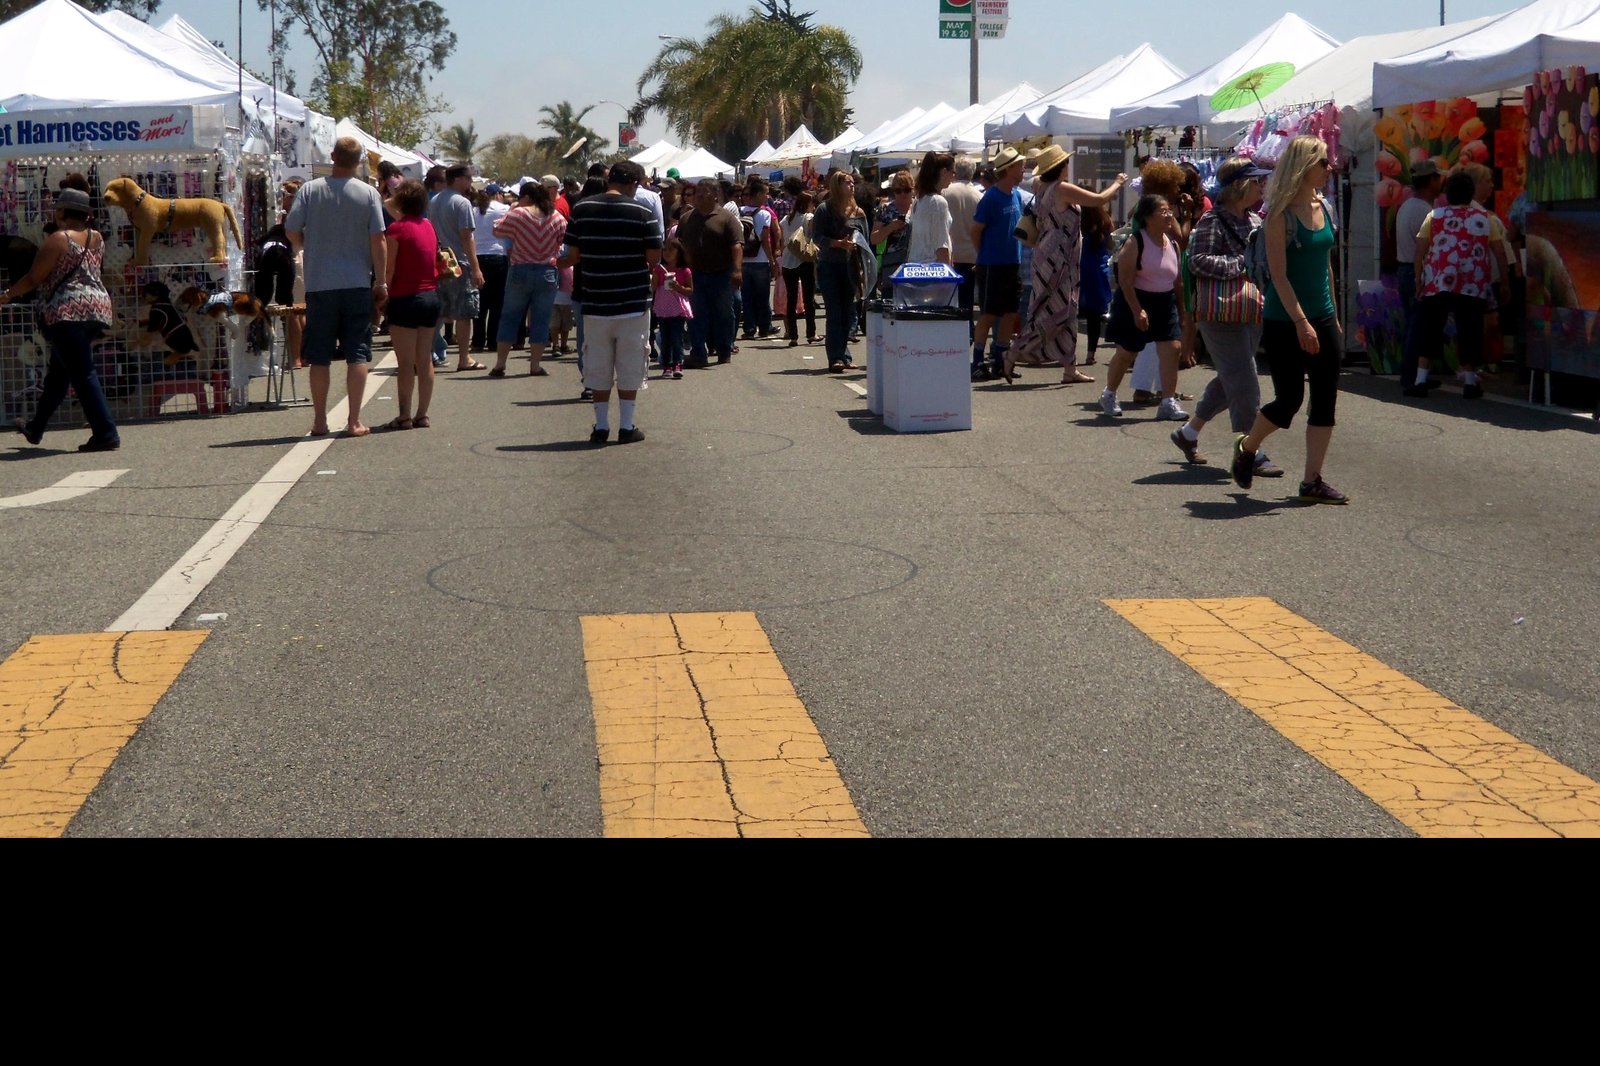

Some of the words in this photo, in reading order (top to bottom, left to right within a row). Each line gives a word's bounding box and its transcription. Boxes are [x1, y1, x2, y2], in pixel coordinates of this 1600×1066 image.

[942, 29, 950, 38] 19
[959, 29, 969, 38] 20
[982, 30, 999, 38] PARK
[149, 113, 176, 126] and
[17, 120, 141, 144] Harnesses
[137, 119, 189, 142] More!
